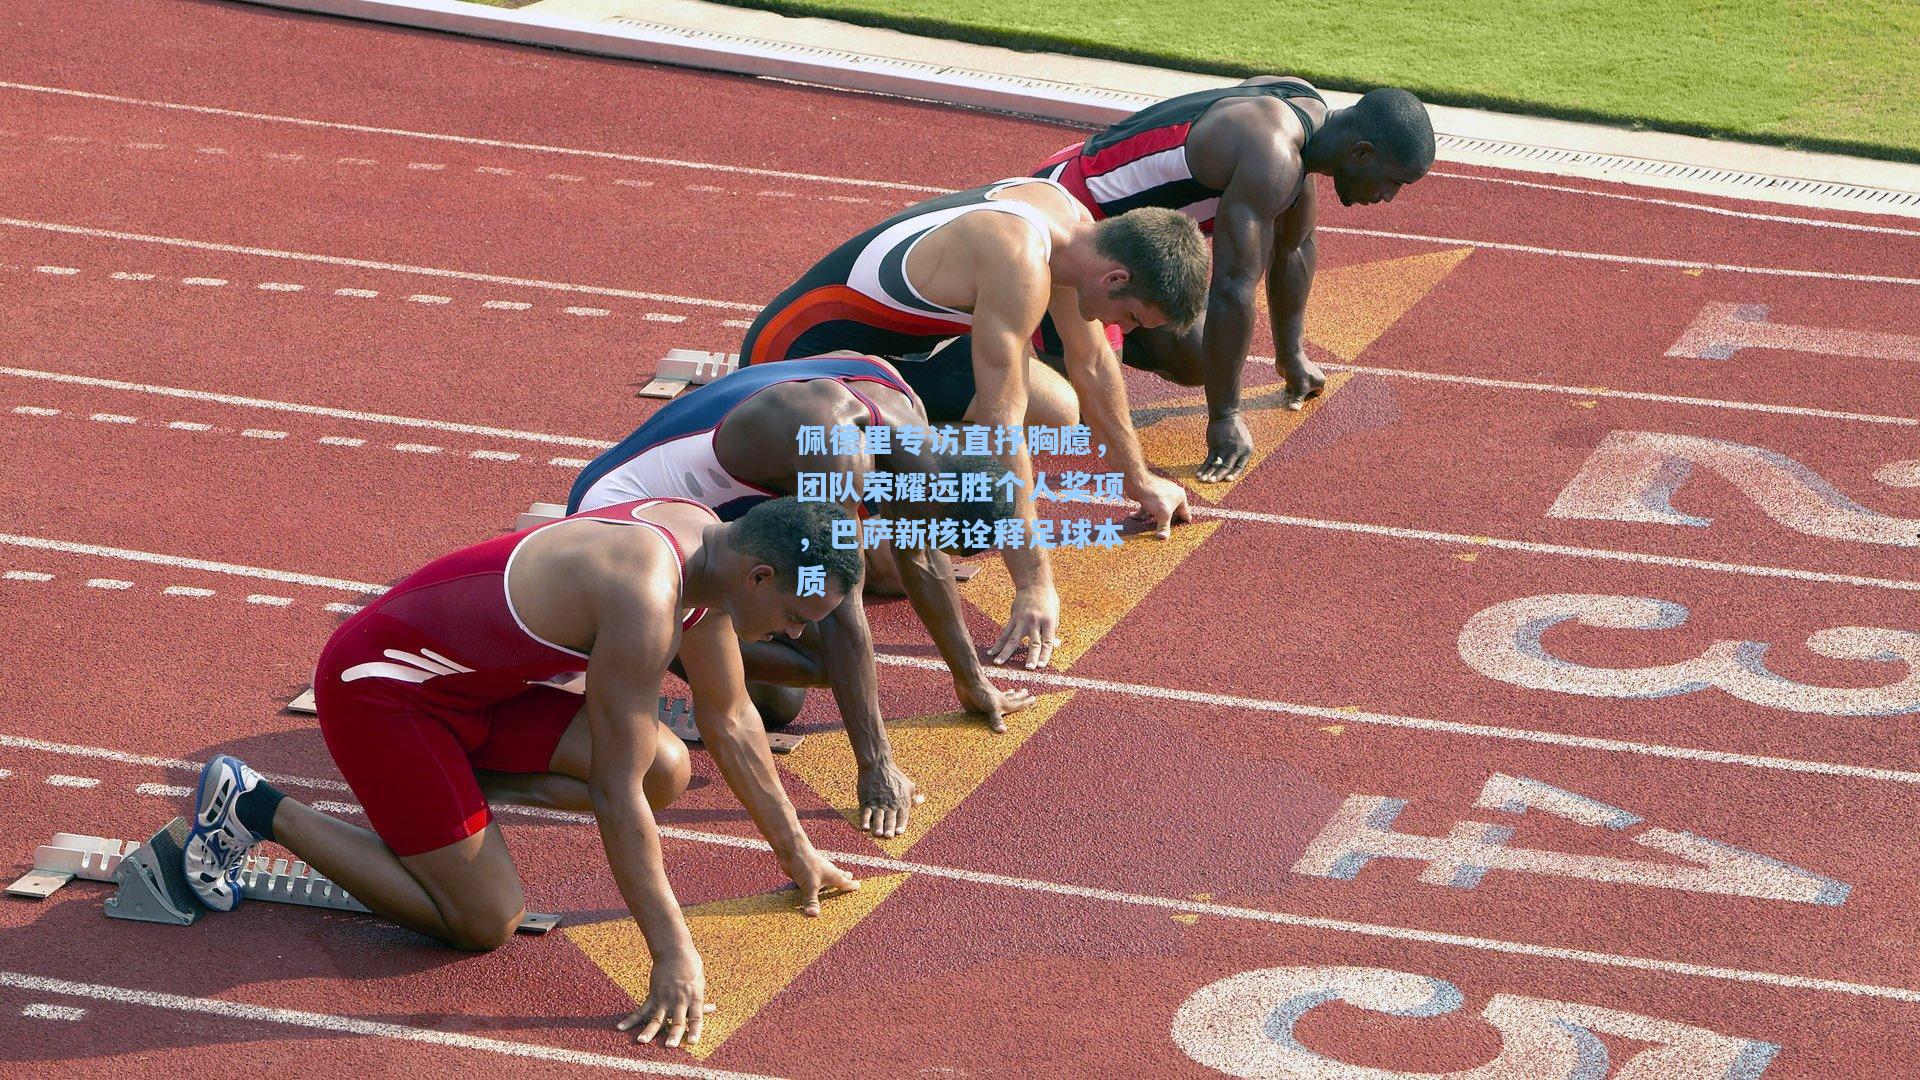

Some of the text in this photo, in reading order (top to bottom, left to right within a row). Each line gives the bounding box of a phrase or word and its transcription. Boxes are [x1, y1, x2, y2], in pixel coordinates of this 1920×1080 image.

[1546, 430, 1920, 548] 2
[1457, 593, 1920, 717] 3
[1291, 773, 1852, 906] 4
[1170, 966, 1782, 1080] 5
